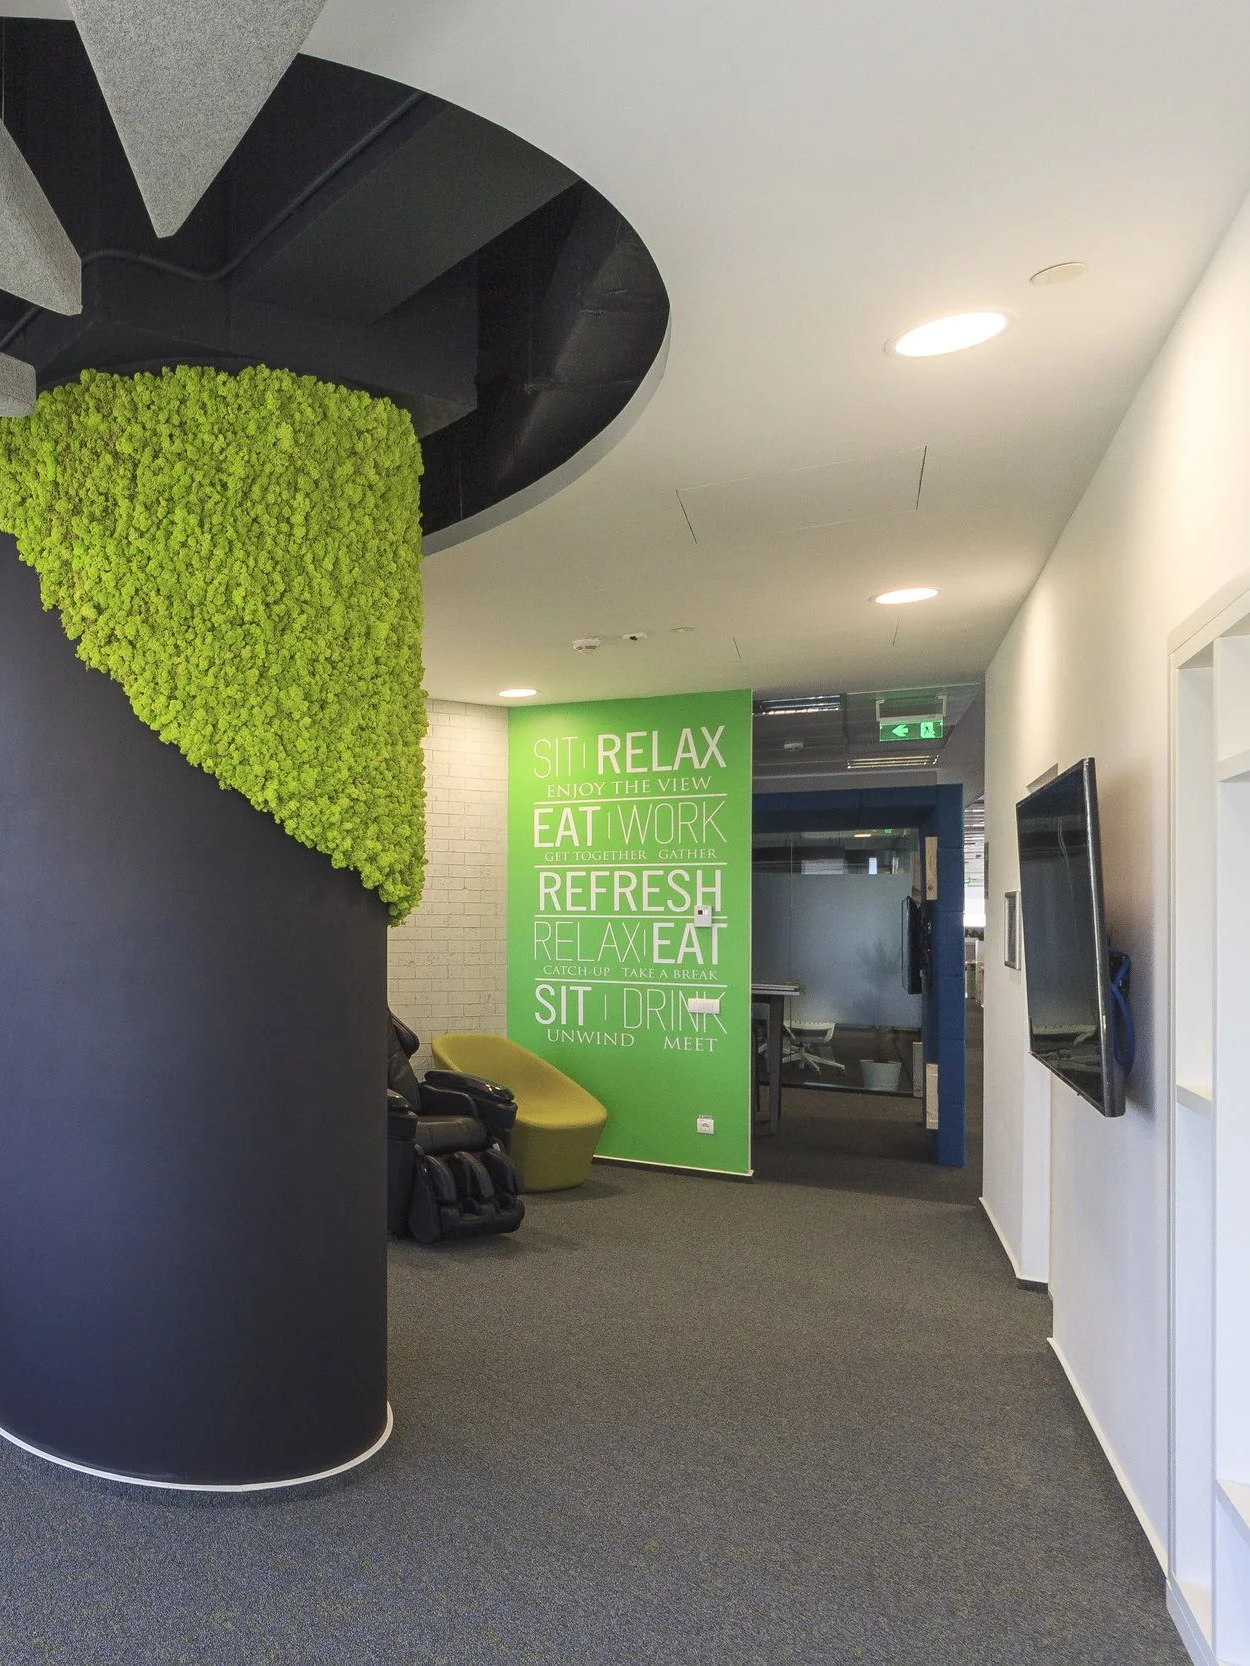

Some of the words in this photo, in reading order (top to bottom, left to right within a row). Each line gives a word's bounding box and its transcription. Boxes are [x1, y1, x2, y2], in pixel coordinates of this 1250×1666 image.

[534, 736, 578, 779] SIT
[597, 725, 726, 776] RELAX
[547, 782, 605, 799] ENJOY
[612, 780, 651, 794] THE
[657, 775, 712, 792] VIEW
[534, 805, 601, 848] EAT
[617, 800, 727, 845] WORK
[544, 851, 571, 863] GET
[574, 850, 647, 862] TOGETHER
[658, 848, 718, 861] GATHER
[539, 869, 722, 912] REFRESH
[534, 921, 640, 963] RELAX
[653, 922, 728, 965] EAT
[543, 965, 611, 978] CATCH-UP
[621, 967, 655, 979] TAKE
[659, 968, 669, 979] A
[673, 968, 719, 981] BREAK
[535, 984, 592, 1026] SIT
[547, 1029, 636, 1047] UNWIND
[664, 1035, 718, 1053] MEET
